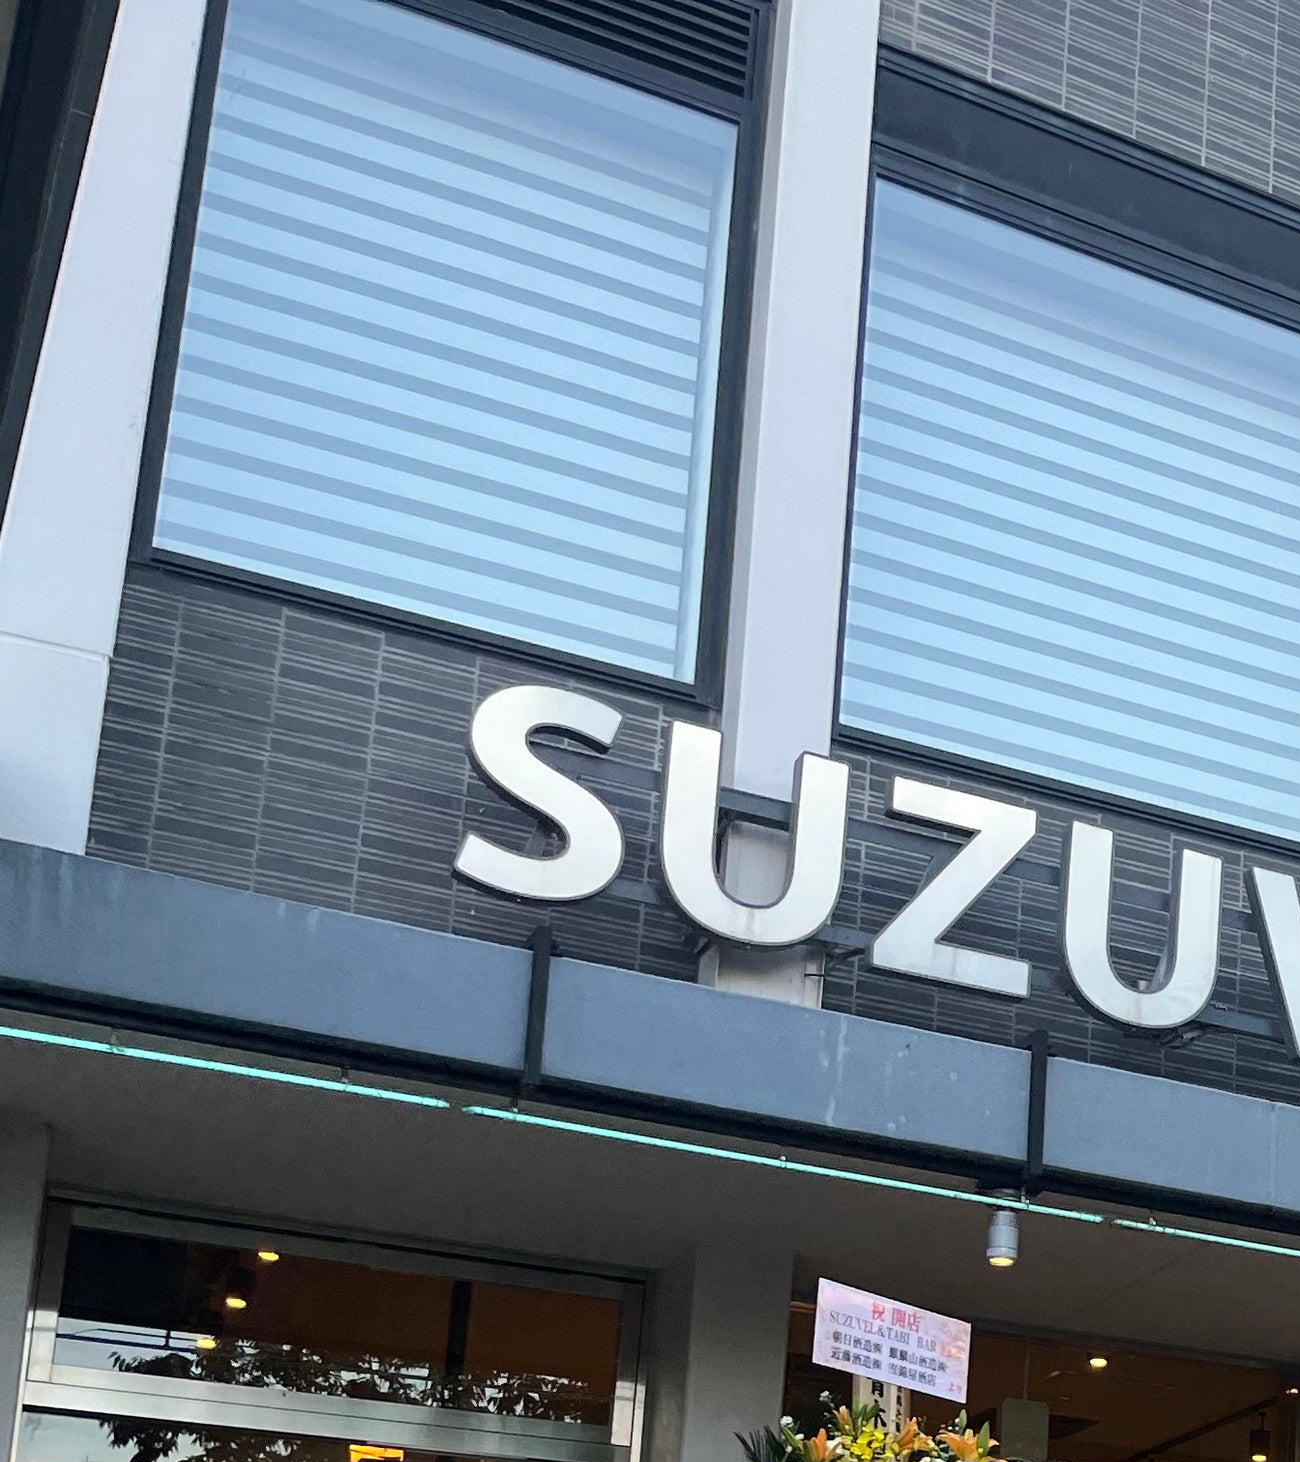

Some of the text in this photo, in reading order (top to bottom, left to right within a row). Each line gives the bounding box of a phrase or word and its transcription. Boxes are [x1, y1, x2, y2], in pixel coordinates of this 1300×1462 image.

[871, 1301, 922, 1333] 祝 開店
[917, 1336, 937, 1350] BAR
